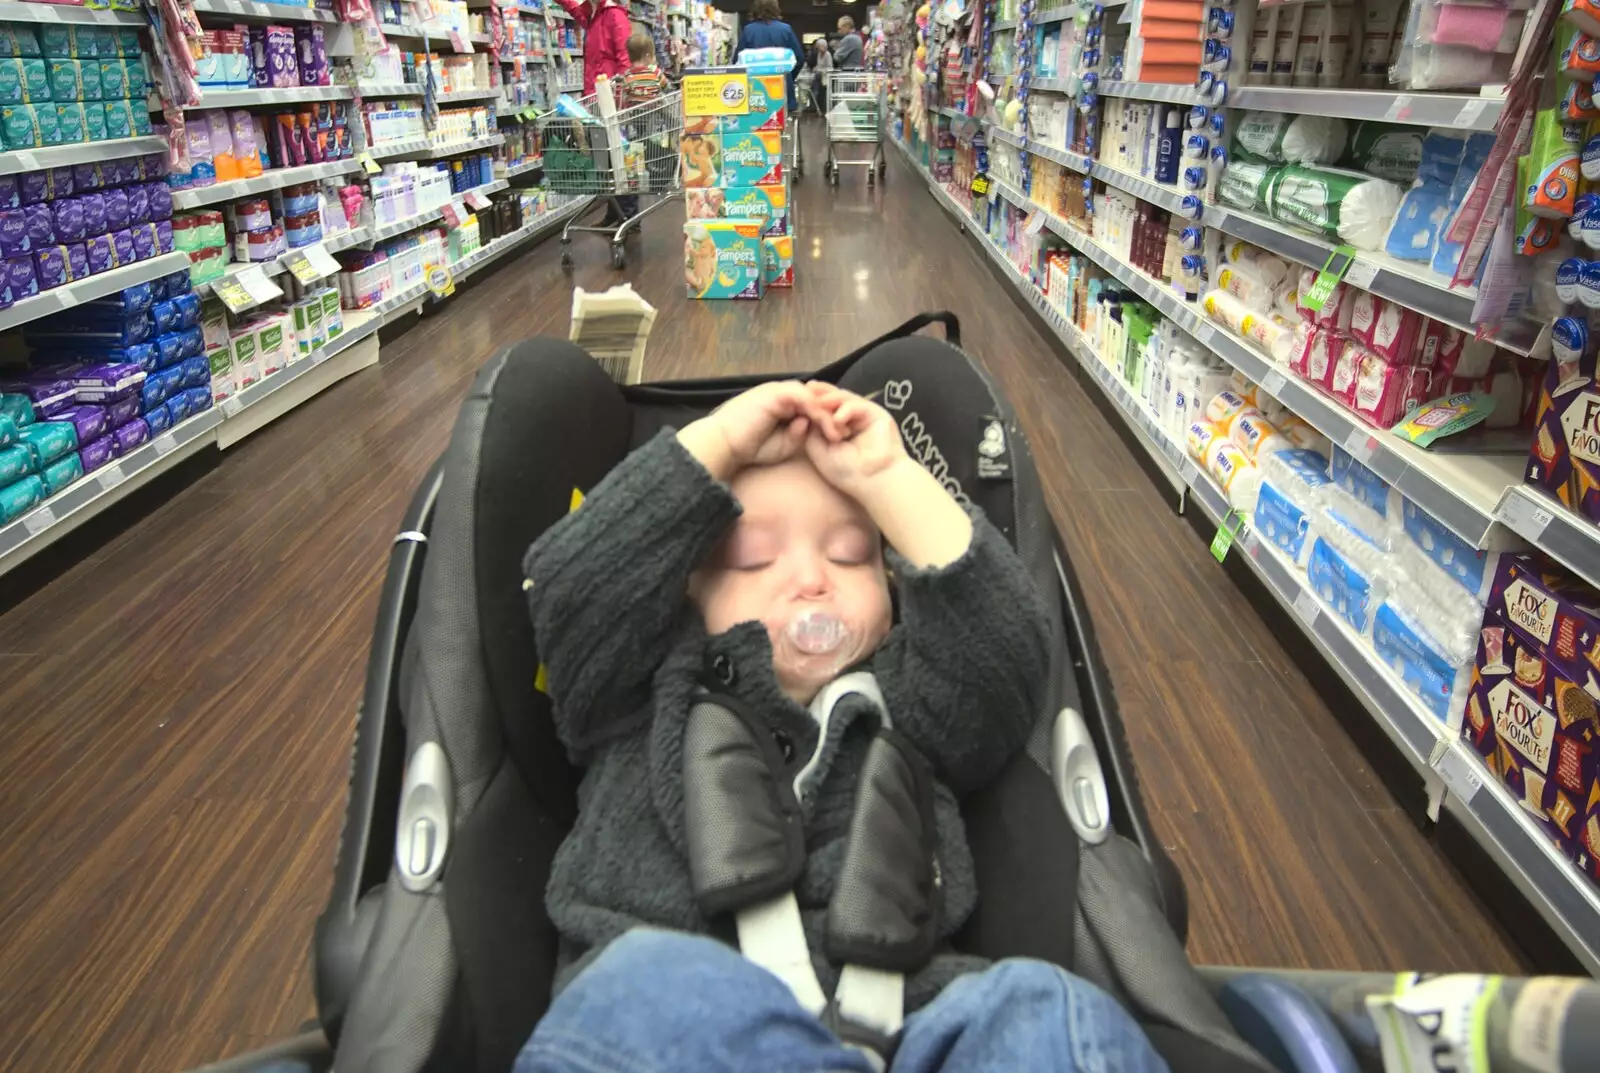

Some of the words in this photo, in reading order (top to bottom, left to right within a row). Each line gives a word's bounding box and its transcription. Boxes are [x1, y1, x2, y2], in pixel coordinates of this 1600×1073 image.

[722, 88, 745, 100] €25
[722, 147, 763, 168] Pampers
[725, 201, 768, 220] Pampers
[716, 248, 755, 265] Pampers
[1571, 428, 1600, 456] FAVO
[1510, 602, 1551, 638] FAVOURITES
[1505, 689, 1544, 739] FOX'S
[1496, 709, 1549, 763] FAVOURITES
